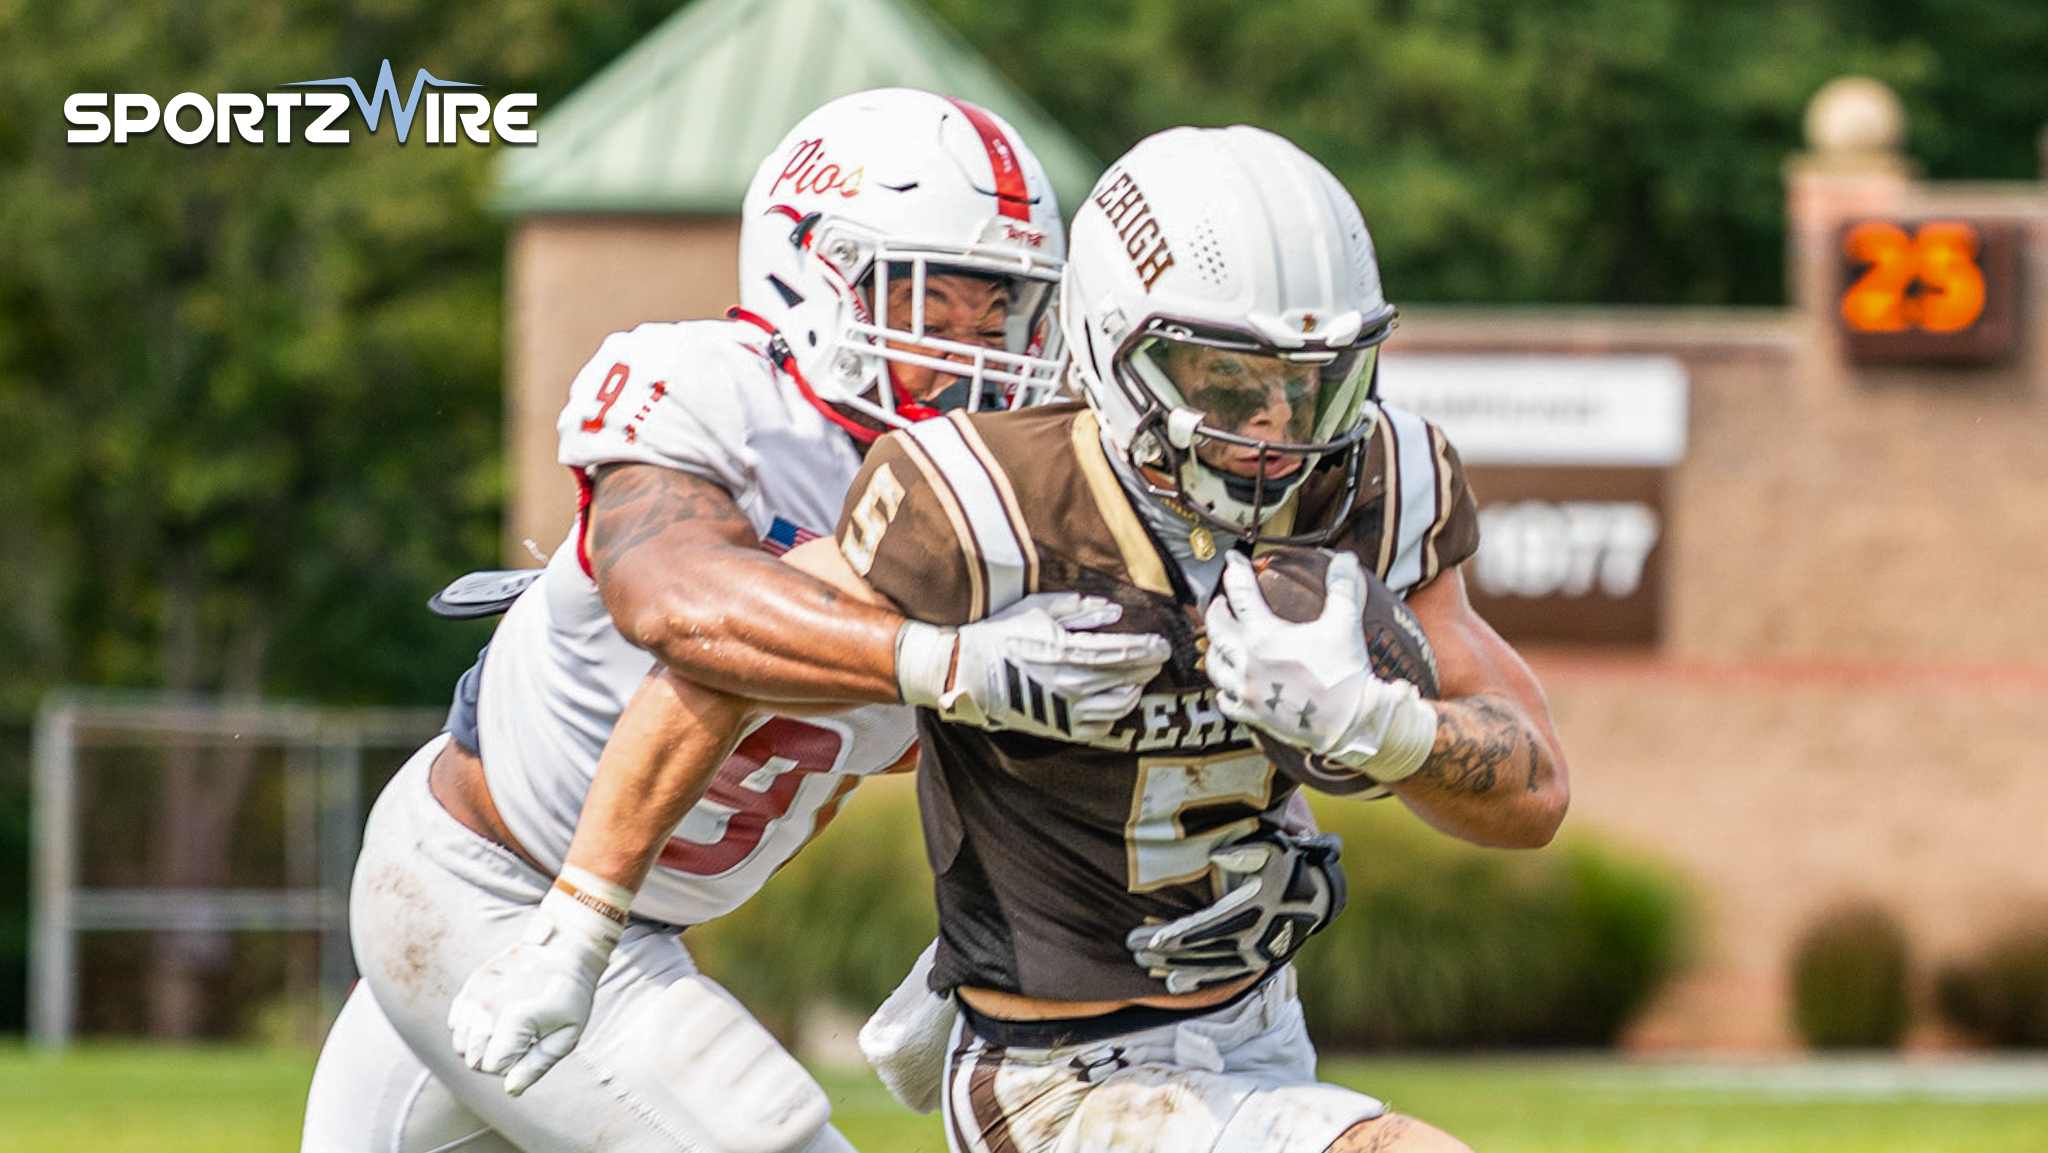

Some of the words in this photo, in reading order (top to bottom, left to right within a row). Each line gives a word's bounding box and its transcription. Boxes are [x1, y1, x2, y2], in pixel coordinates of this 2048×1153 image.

[769, 138, 864, 198] Pios
[1842, 220, 1986, 332] 25
[581, 362, 630, 434] 9
[840, 462, 906, 577] 5
[1086, 686, 1254, 753] LEH
[1125, 746, 1278, 893] 5
